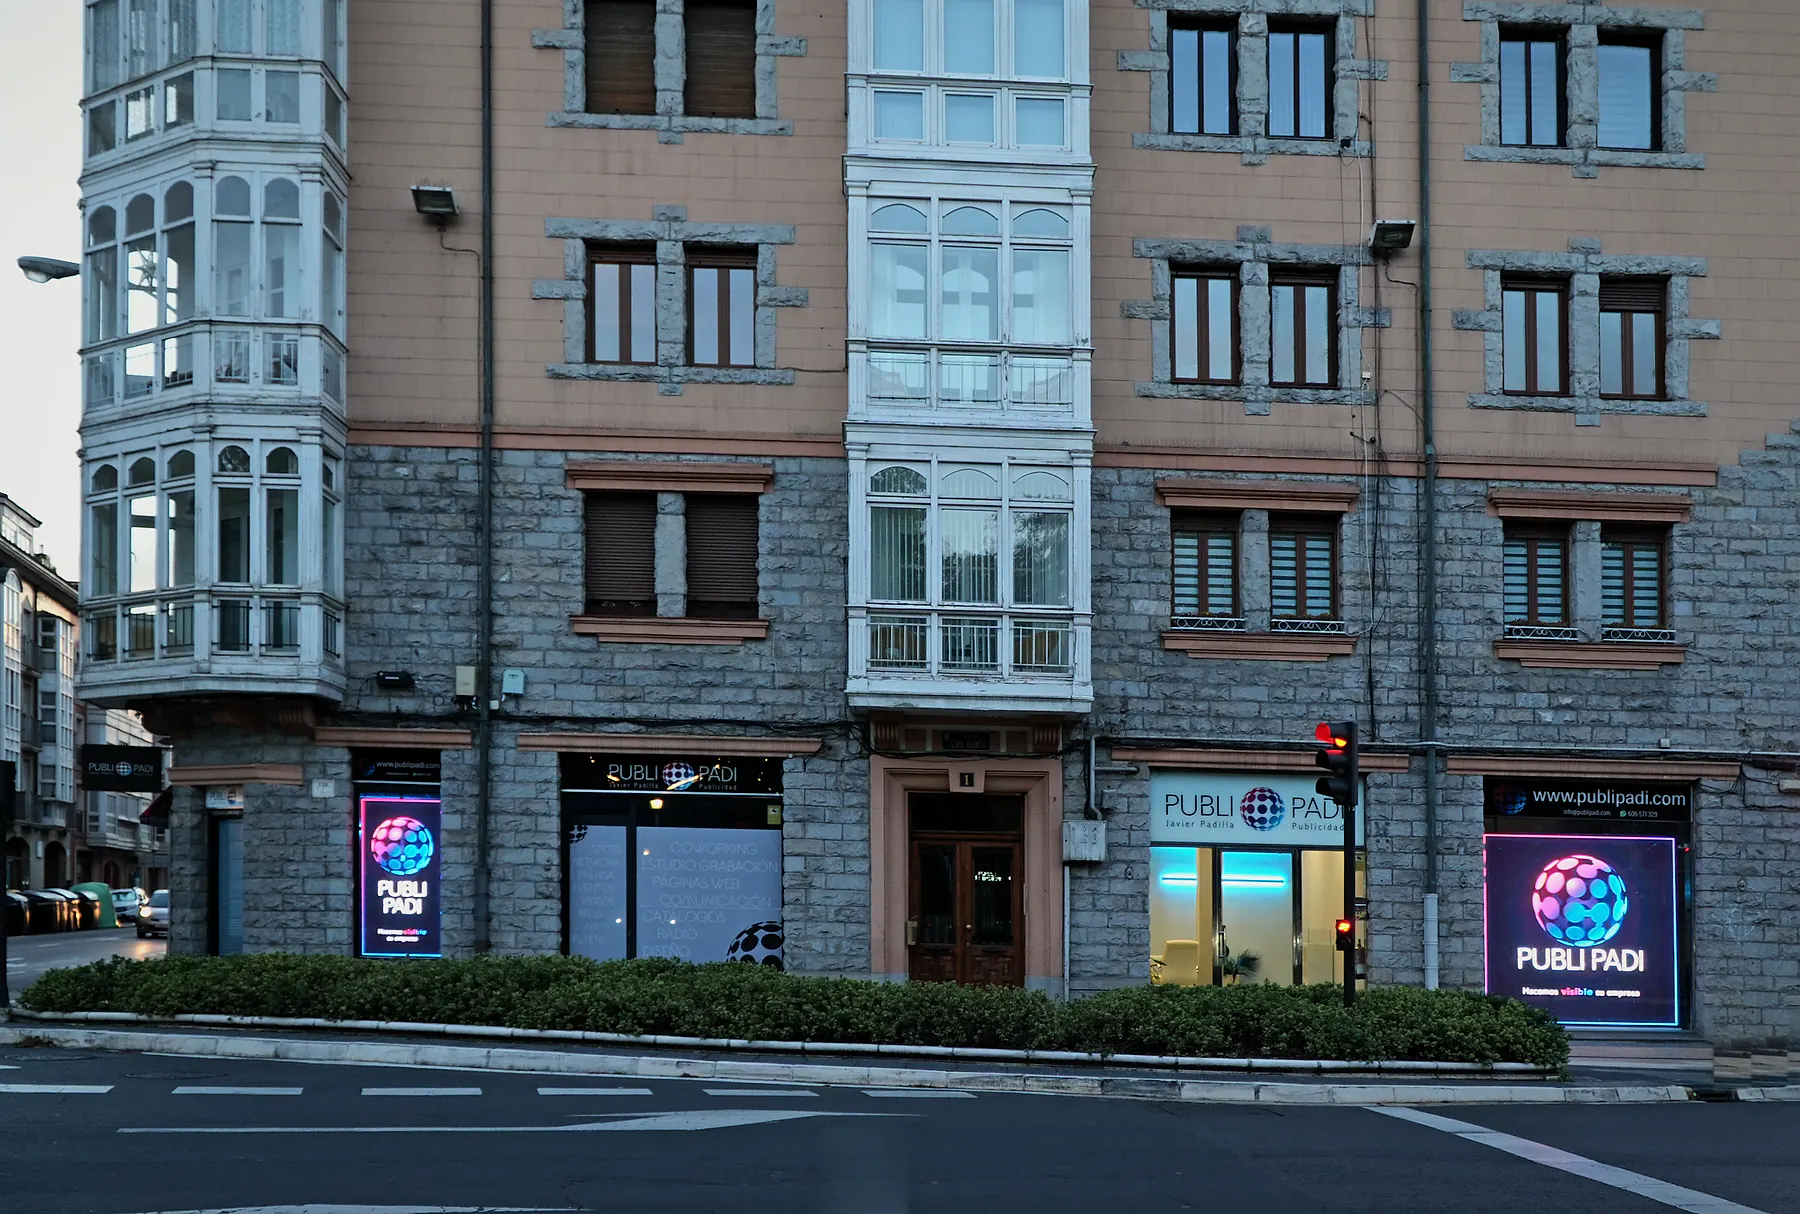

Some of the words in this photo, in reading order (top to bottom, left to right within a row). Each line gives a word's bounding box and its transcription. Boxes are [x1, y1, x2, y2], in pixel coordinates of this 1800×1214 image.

[88, 762, 114, 772] PUBLI
[133, 764, 154, 773] PADI
[376, 761, 440, 769] www.publipadi.com
[608, 764, 658, 781] PUBLI
[698, 766, 736, 783] PADI
[698, 783, 737, 791] Publicidad
[1165, 794, 1234, 817] PUBLI
[1533, 789, 1686, 807] www.publipadi.com
[1563, 809, 1612, 817] info@publipadi.com
[1165, 820, 1194, 828] Javier
[1200, 820, 1234, 829] Padilla
[670, 841, 757, 855] COWORKING
[641, 858, 695, 871] ESTUDIO
[698, 857, 777, 873] GRABACIÓN
[377, 880, 428, 898] PUBLI
[652, 873, 706, 889] PÁGINAS
[710, 878, 739, 890] WEB
[383, 897, 423, 915] PADI
[659, 892, 771, 908] COMUNICACIÓN
[642, 908, 726, 923] CATÁLOGOS
[657, 927, 697, 940] RADIO
[642, 943, 690, 957] DISEÑO
[1517, 947, 1585, 971] PUBLI
[1591, 948, 1644, 972] PADI
[1560, 987, 1593, 996] visible
